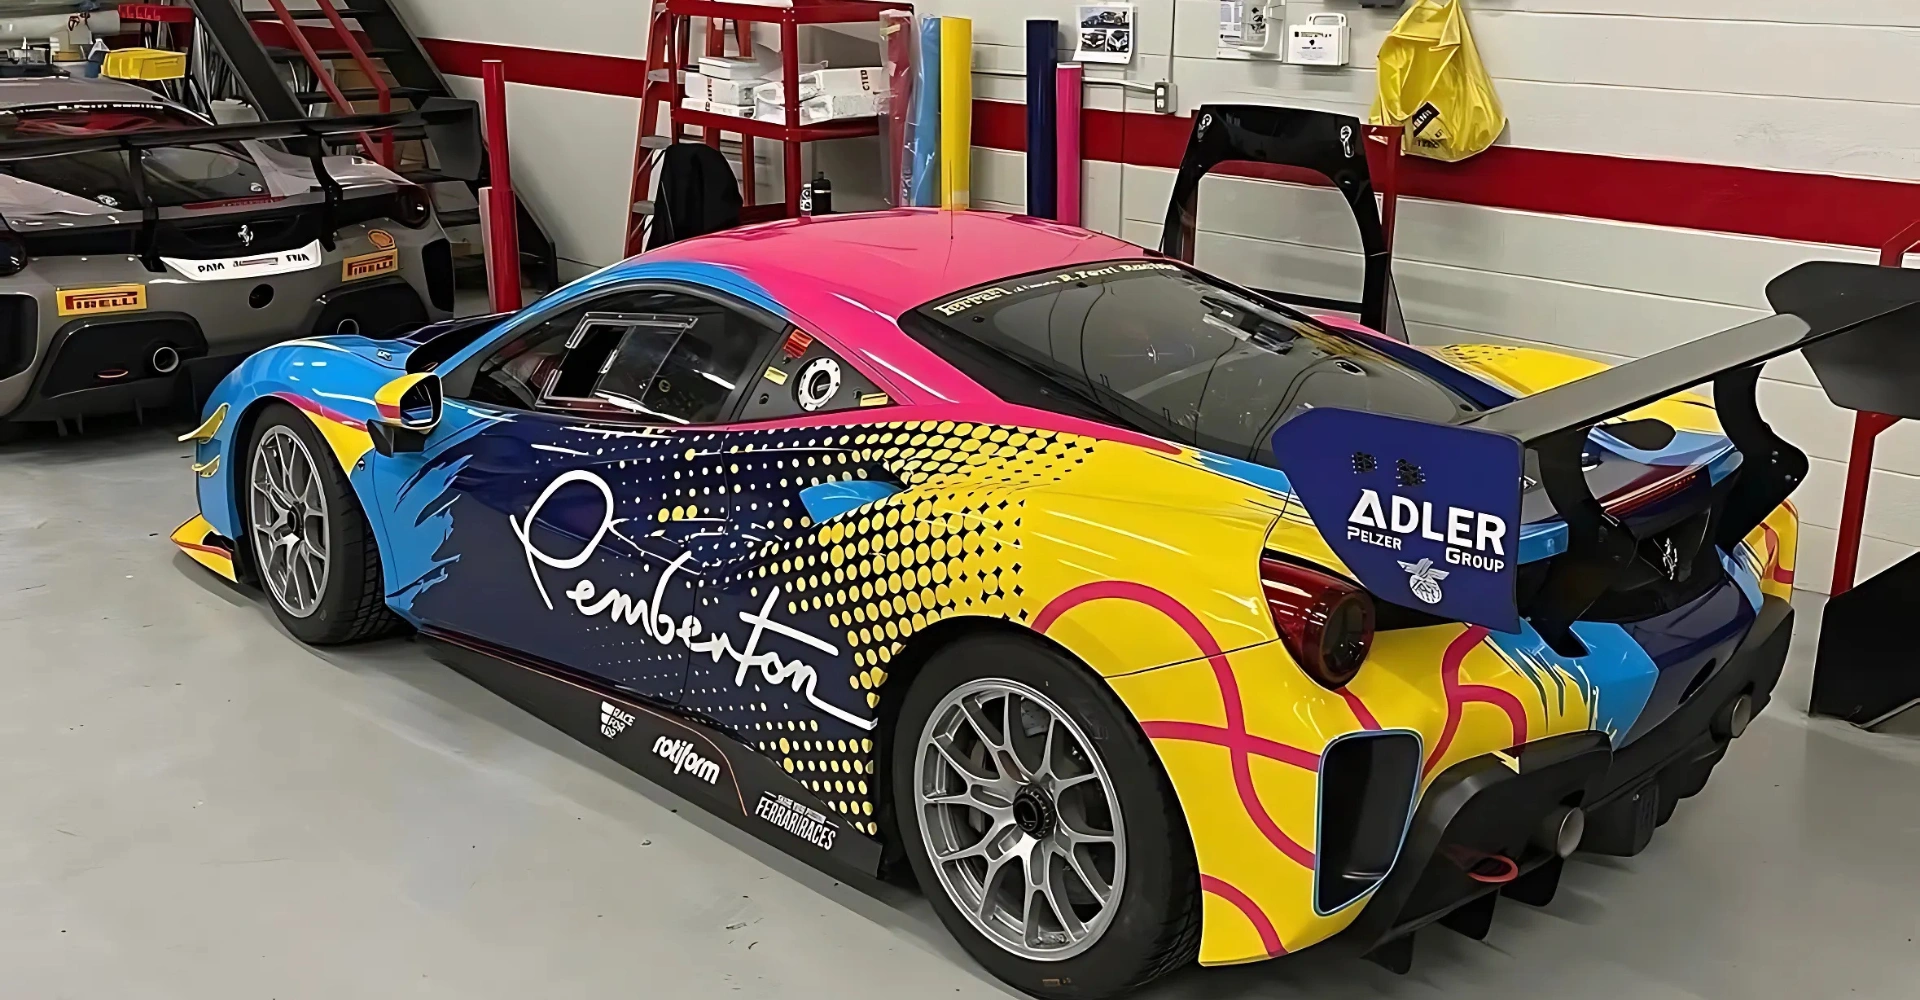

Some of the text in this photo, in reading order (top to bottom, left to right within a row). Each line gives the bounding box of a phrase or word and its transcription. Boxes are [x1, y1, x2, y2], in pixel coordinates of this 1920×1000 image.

[347, 254, 394, 277] PIRELLI
[65, 291, 138, 310] PIRELLI
[1348, 488, 1507, 556] ADLER
[1347, 525, 1402, 551] PELZER
[1445, 546, 1505, 573] GROUP
[509, 469, 878, 730] Pemberton
[651, 735, 721, 785] rotiform
